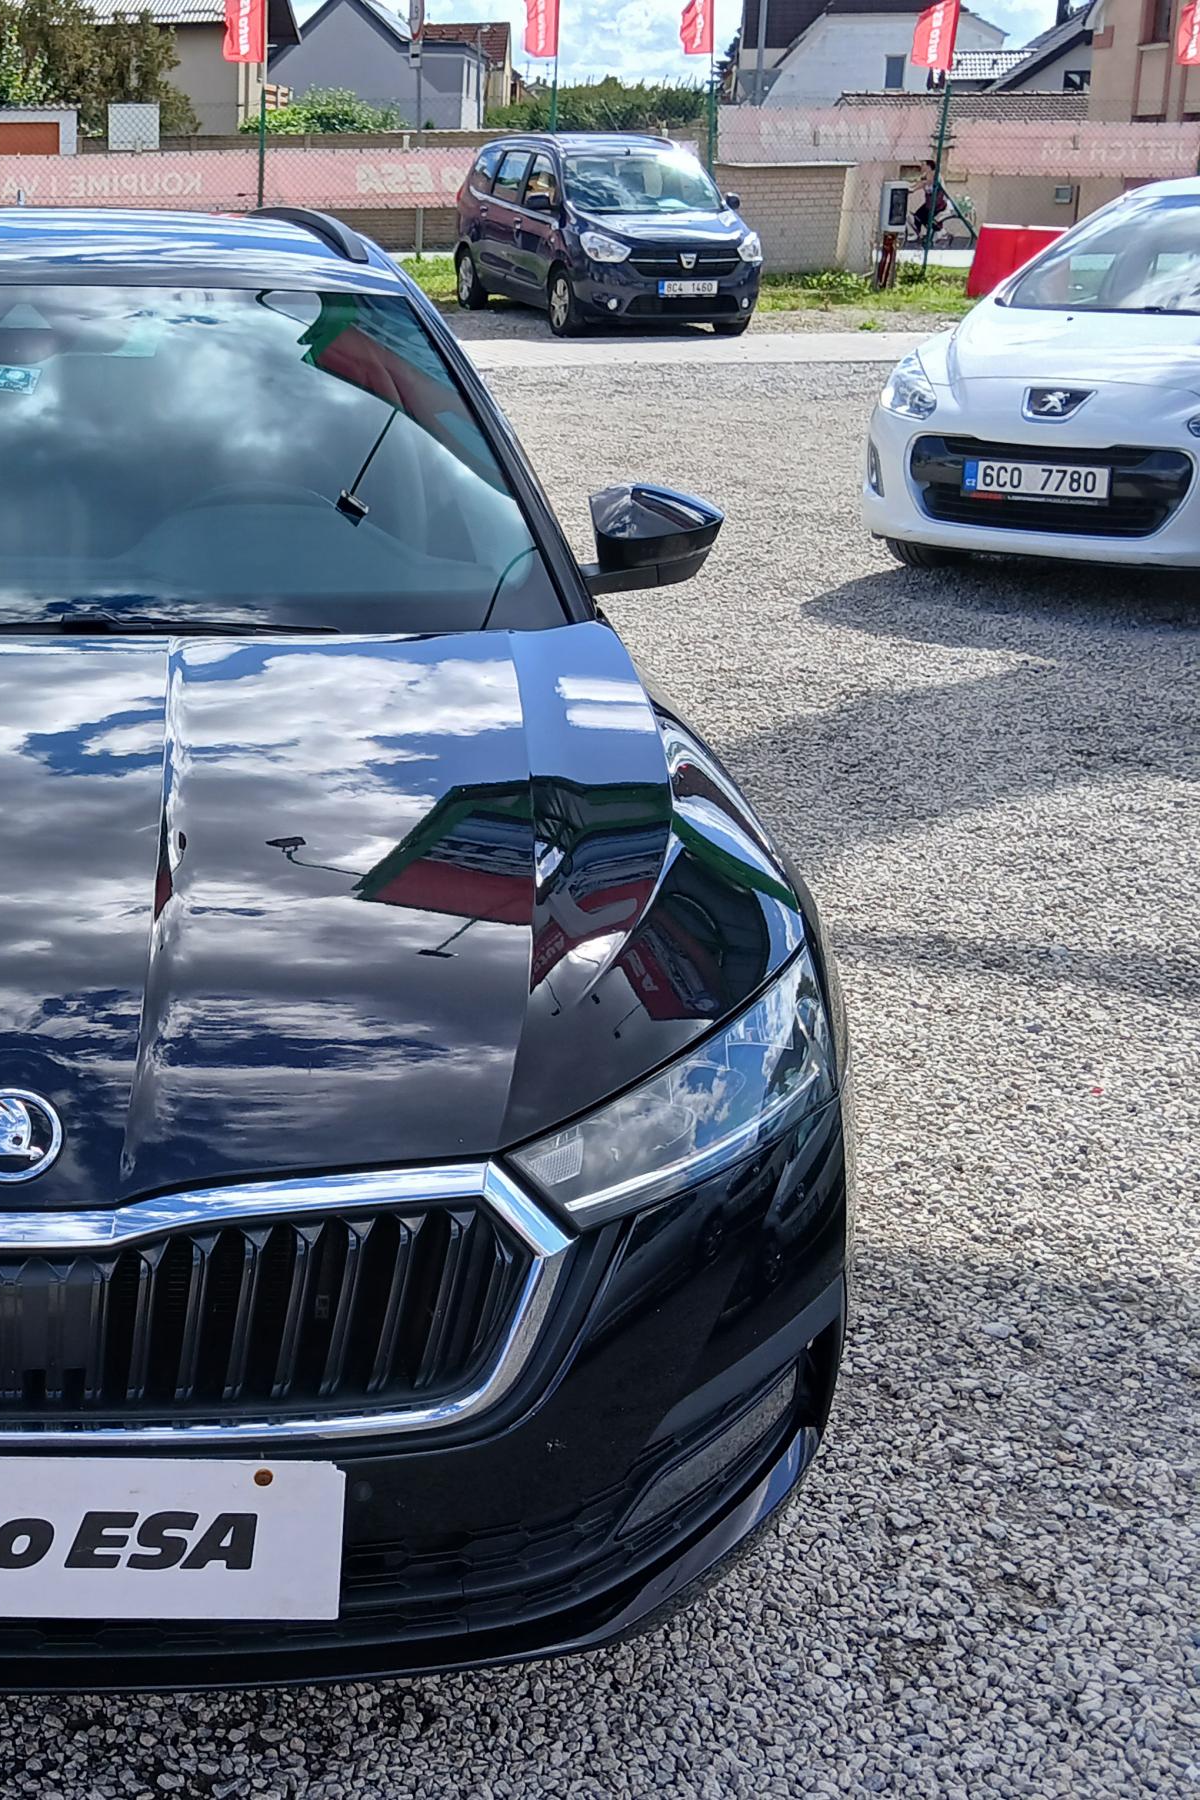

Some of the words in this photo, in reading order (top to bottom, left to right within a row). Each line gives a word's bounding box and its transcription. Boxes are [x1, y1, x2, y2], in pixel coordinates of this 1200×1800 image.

[982, 465, 1023, 489] 6C0
[1040, 468, 1097, 494] 7780
[63, 1510, 260, 1571] ESA
